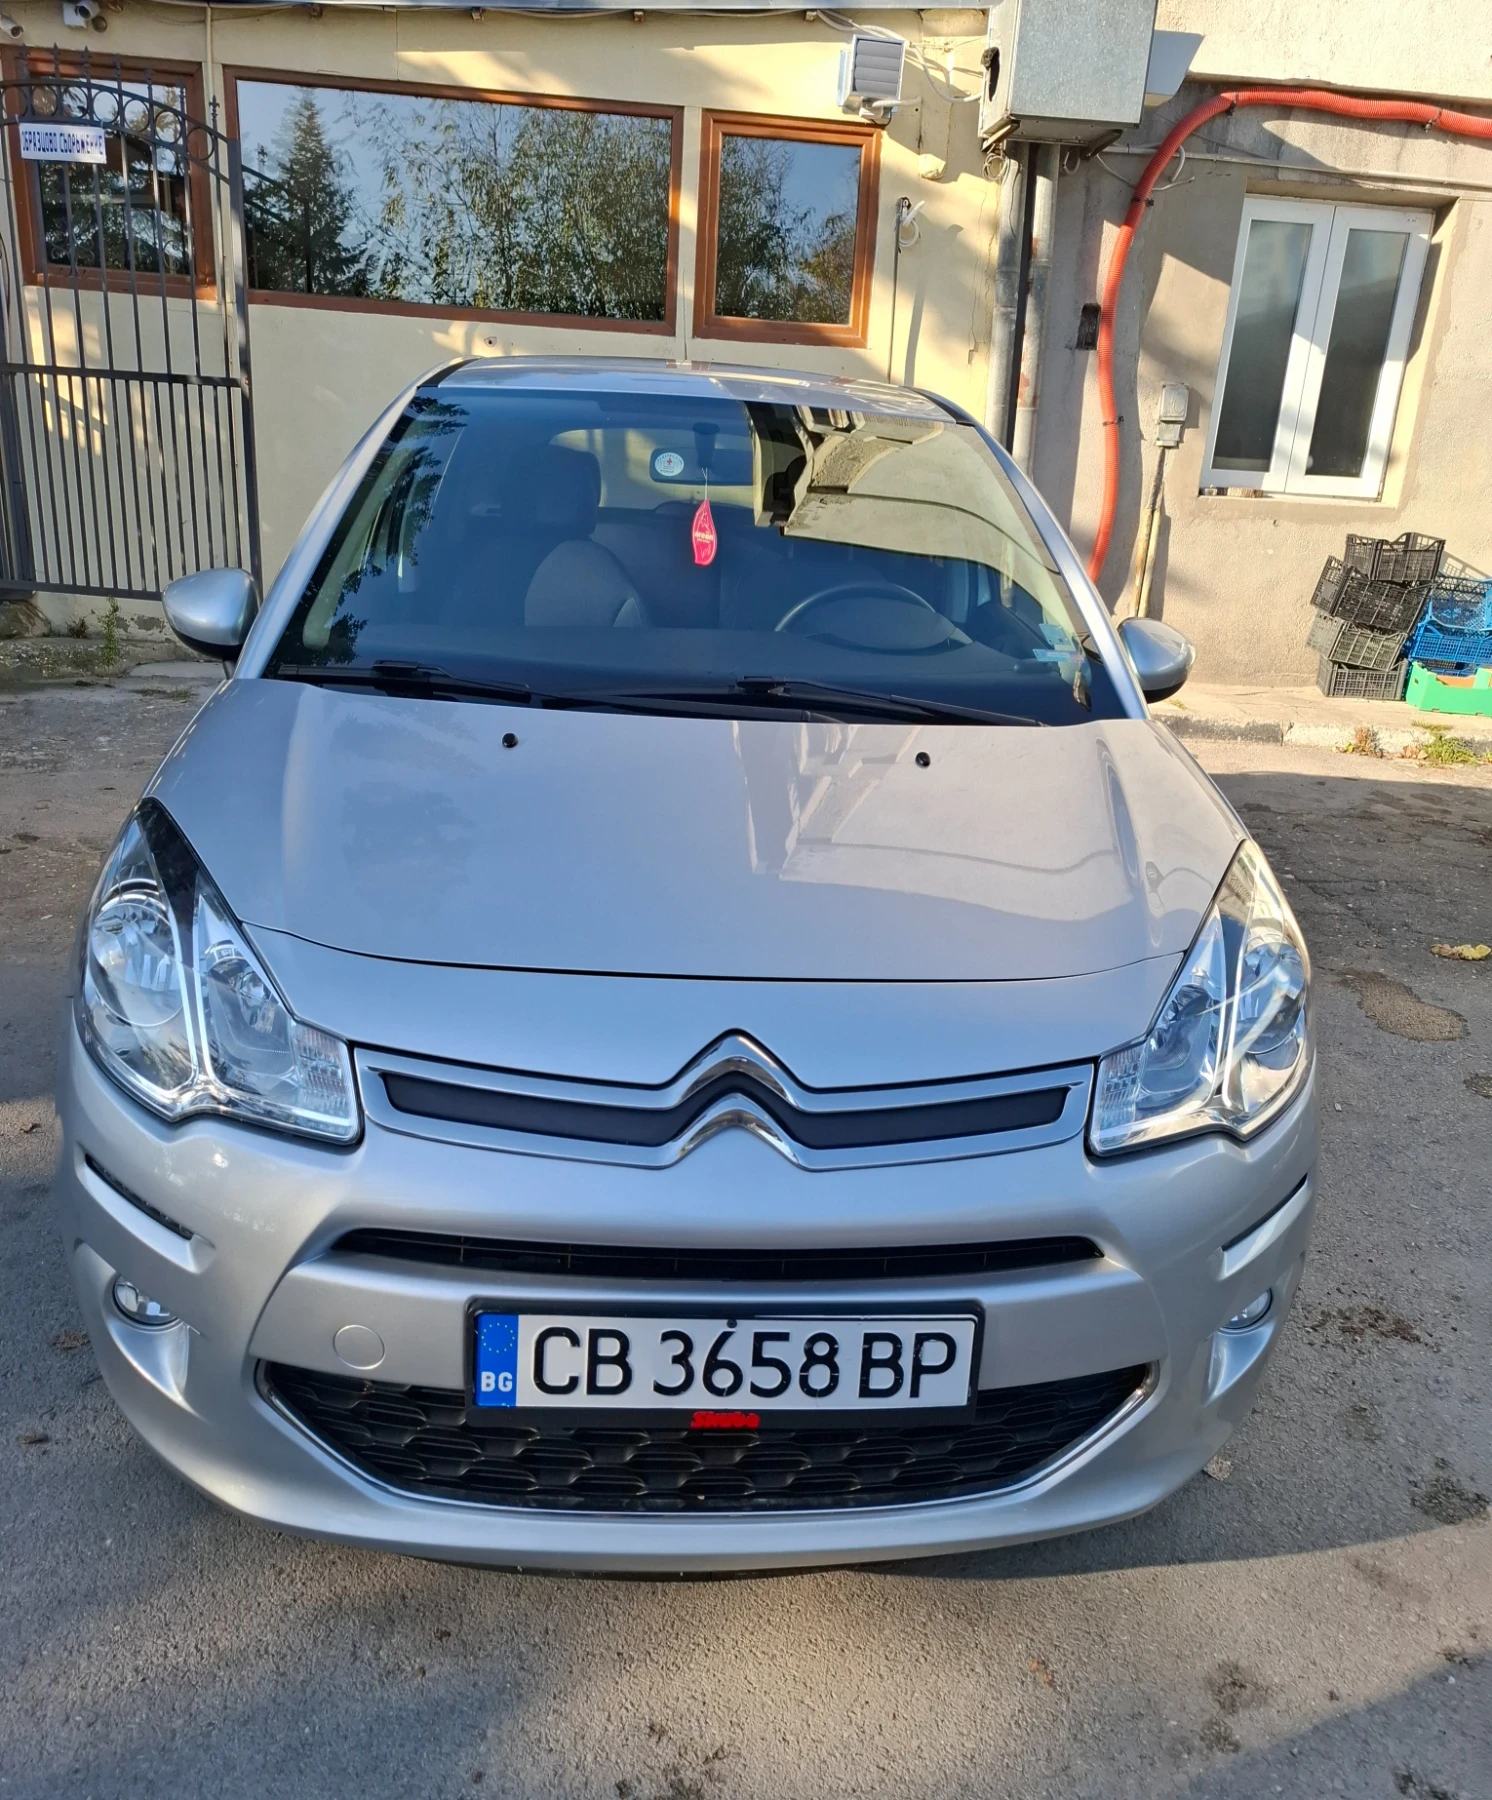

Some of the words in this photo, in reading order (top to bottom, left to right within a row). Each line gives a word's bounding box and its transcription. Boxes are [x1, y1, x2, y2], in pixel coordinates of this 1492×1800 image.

[481, 1371, 513, 1392] BG
[534, 1326, 633, 1395] CB
[653, 1330, 840, 1398] 3658
[858, 1332, 957, 1398] BP
